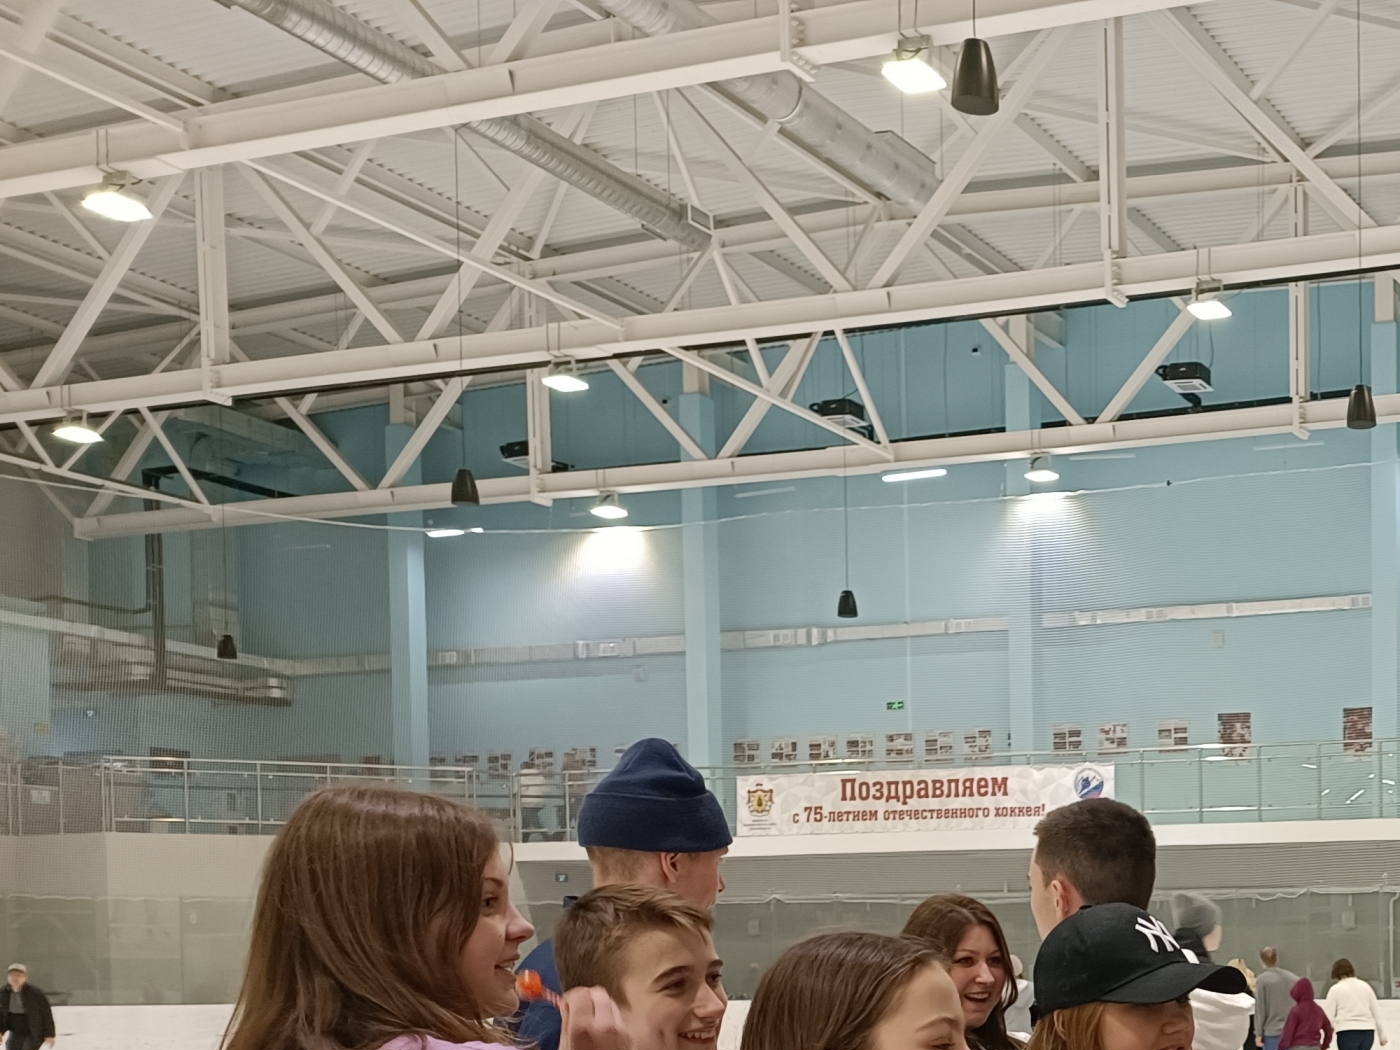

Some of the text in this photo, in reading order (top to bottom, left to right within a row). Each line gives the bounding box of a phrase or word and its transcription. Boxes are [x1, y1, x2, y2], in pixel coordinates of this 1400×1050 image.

[840, 776, 1009, 806] Поздравляем
[792, 812, 800, 824] с
[803, 805, 878, 823] 75-летием
[883, 806, 990, 822] отечественного
[994, 803, 1046, 818] хоккея!
